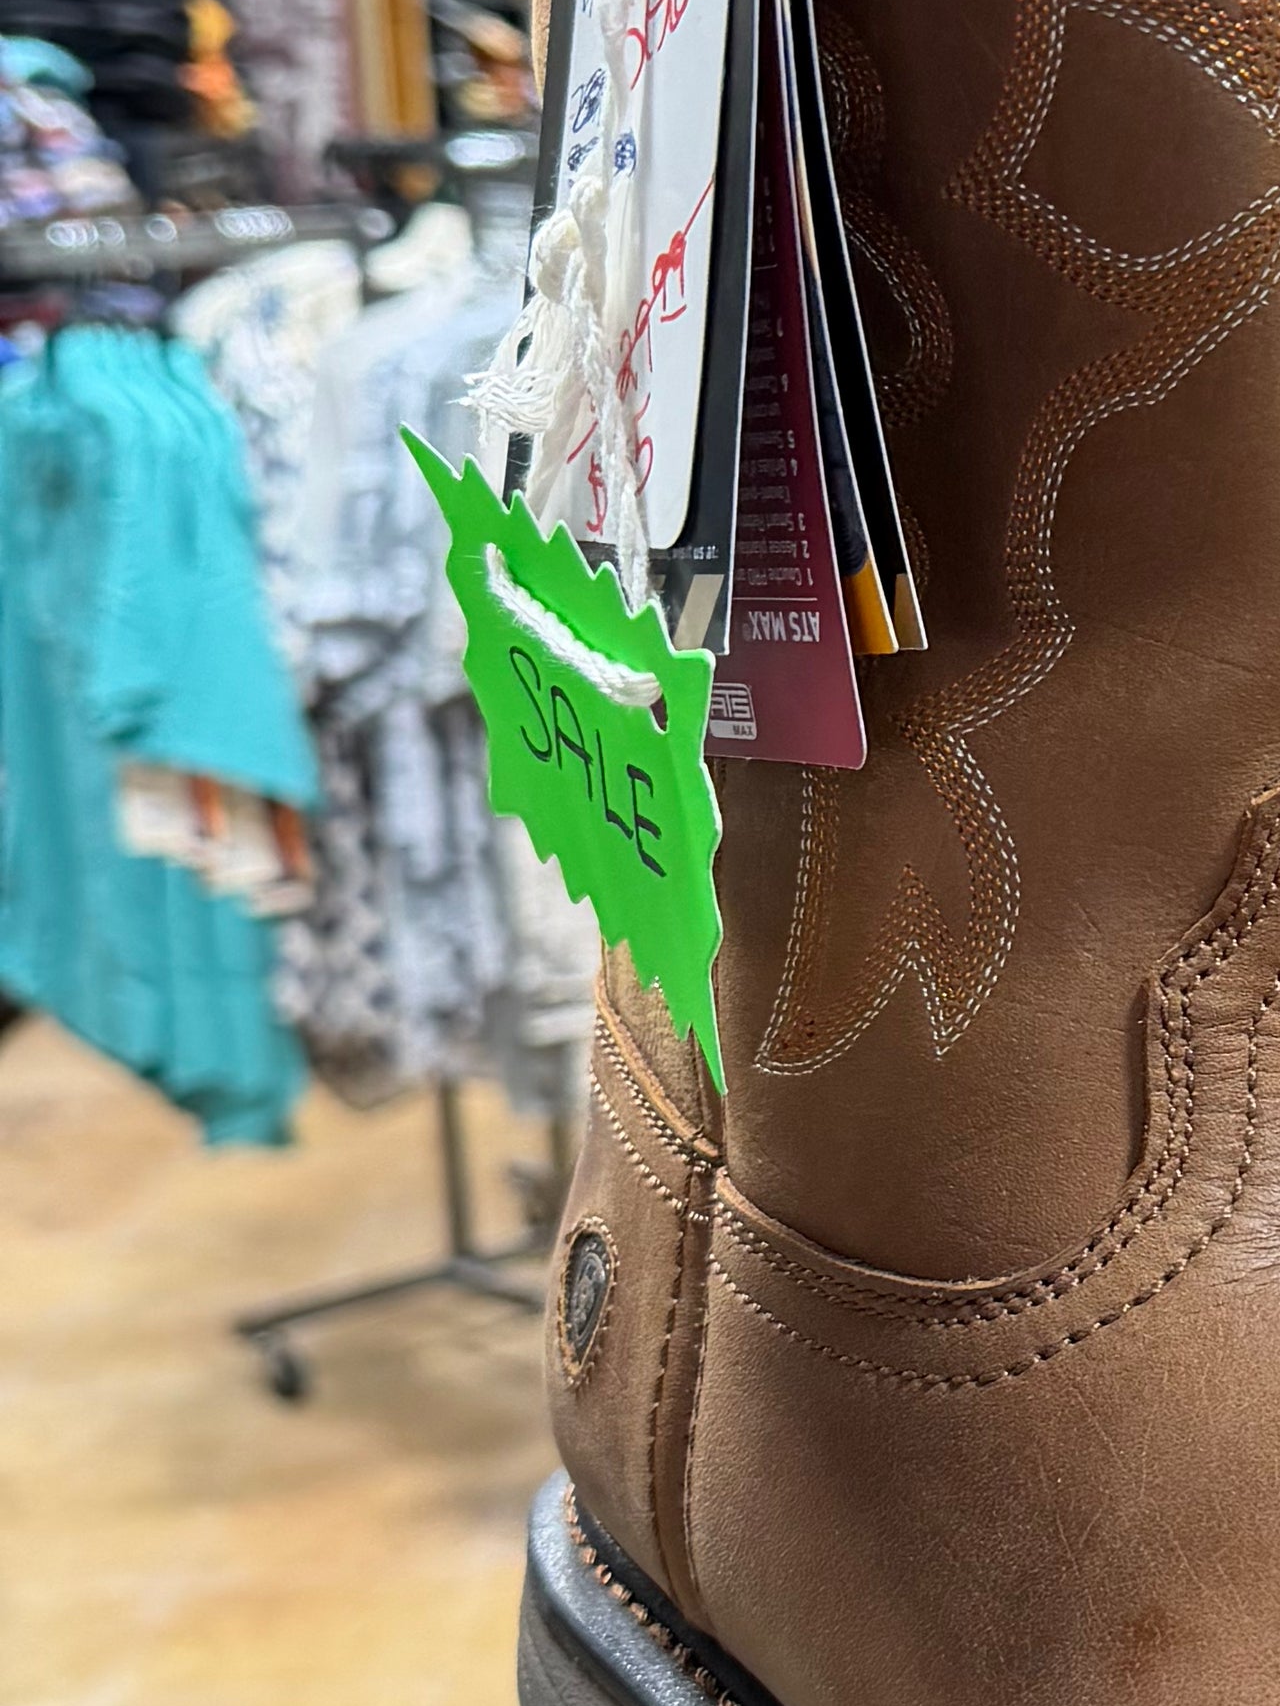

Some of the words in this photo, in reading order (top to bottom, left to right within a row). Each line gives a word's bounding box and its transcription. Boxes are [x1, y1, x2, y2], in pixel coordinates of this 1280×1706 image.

[797, 512, 807, 532] 3
[800, 540, 811, 559] 2
[806, 567, 814, 586] 1
[788, 610, 820, 644] ATS
[508, 645, 667, 878] SALE
